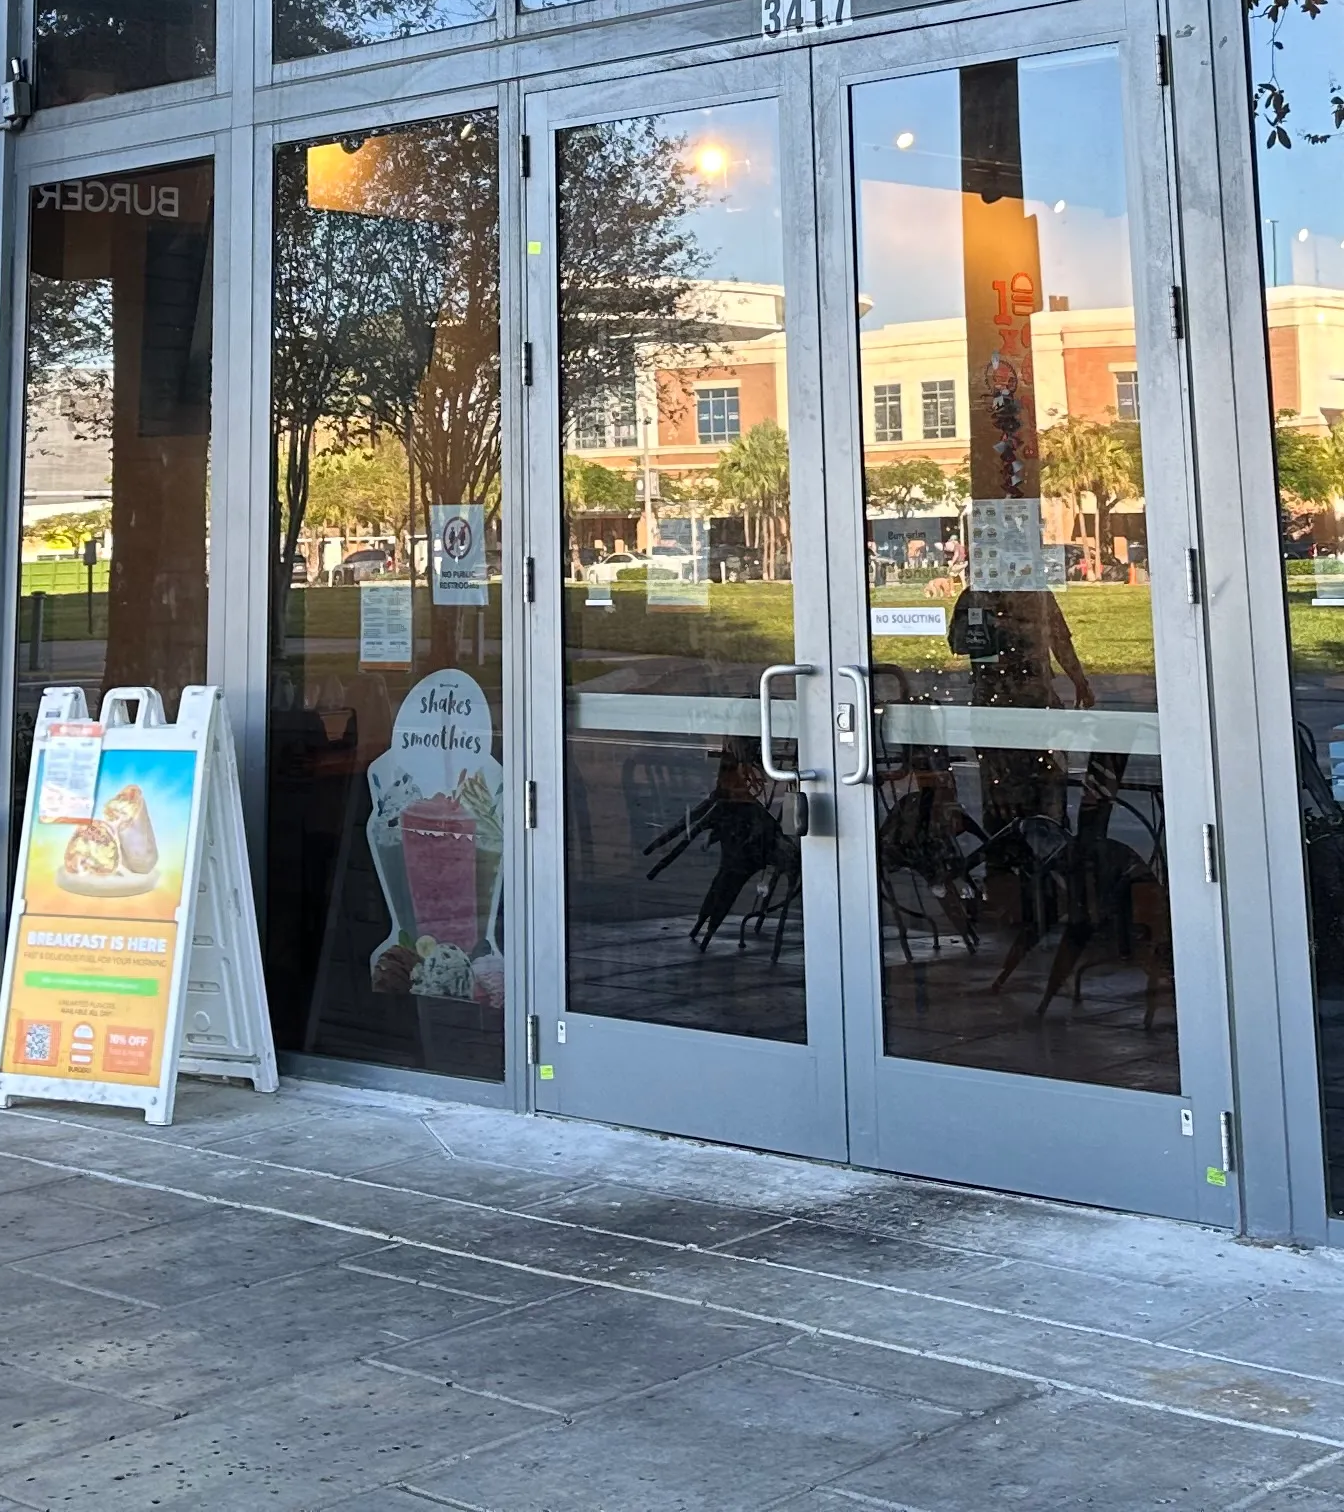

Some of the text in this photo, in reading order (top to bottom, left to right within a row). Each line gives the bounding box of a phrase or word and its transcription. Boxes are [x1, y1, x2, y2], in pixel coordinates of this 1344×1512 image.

[876, 614, 941, 624] NO SOLICITING
[420, 688, 472, 716] shakes
[402, 724, 481, 754] smoothies
[27, 931, 167, 954] BREAKFAST IS HERE
[128, 1035, 148, 1047] OFF
